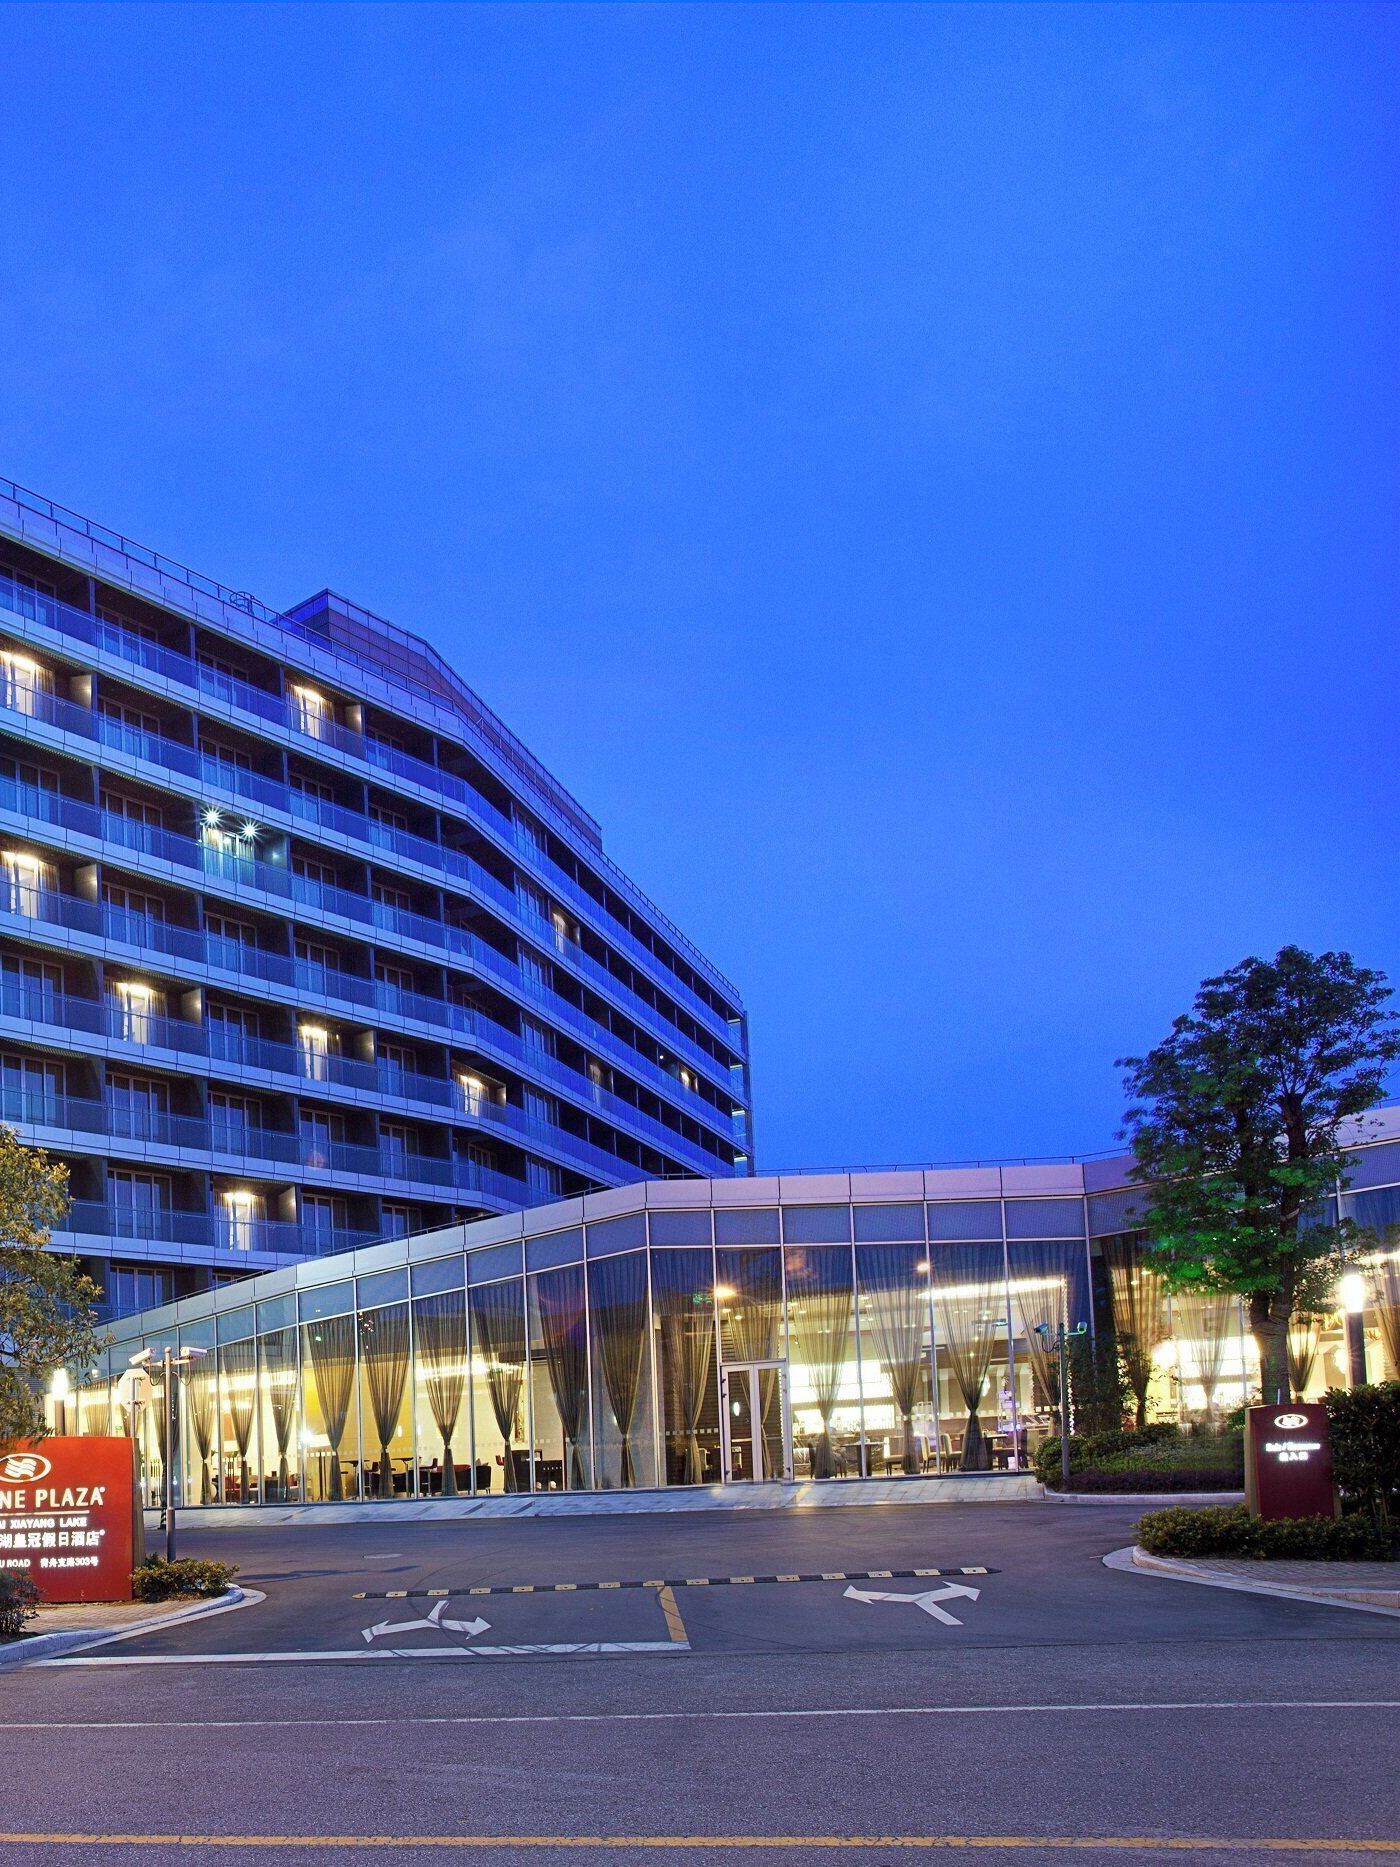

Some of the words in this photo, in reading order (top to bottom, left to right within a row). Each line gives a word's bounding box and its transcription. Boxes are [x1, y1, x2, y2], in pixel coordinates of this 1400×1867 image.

[35, 1487, 104, 1509] PLAZA
[10, 1518, 55, 1529] XIAYANG
[59, 1517, 88, 1528] LAKE
[6, 1558, 31, 1568] ROAD
